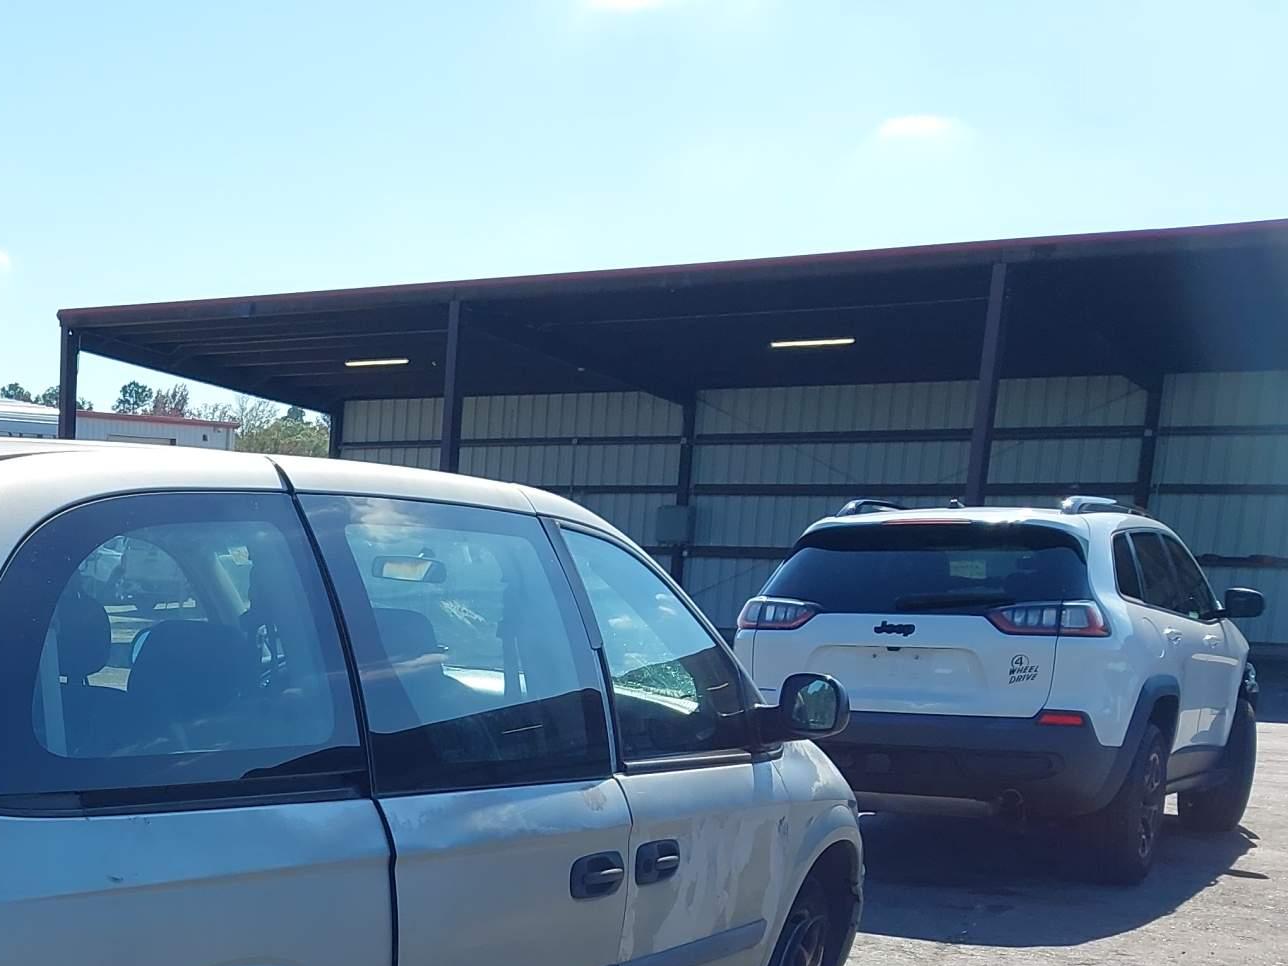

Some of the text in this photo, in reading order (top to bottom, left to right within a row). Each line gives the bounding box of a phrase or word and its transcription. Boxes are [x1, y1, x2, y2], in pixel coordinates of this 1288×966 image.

[874, 620, 915, 637] Jeep
[1009, 665, 1039, 675] WHEEL
[1009, 673, 1038, 684] DRIVE
